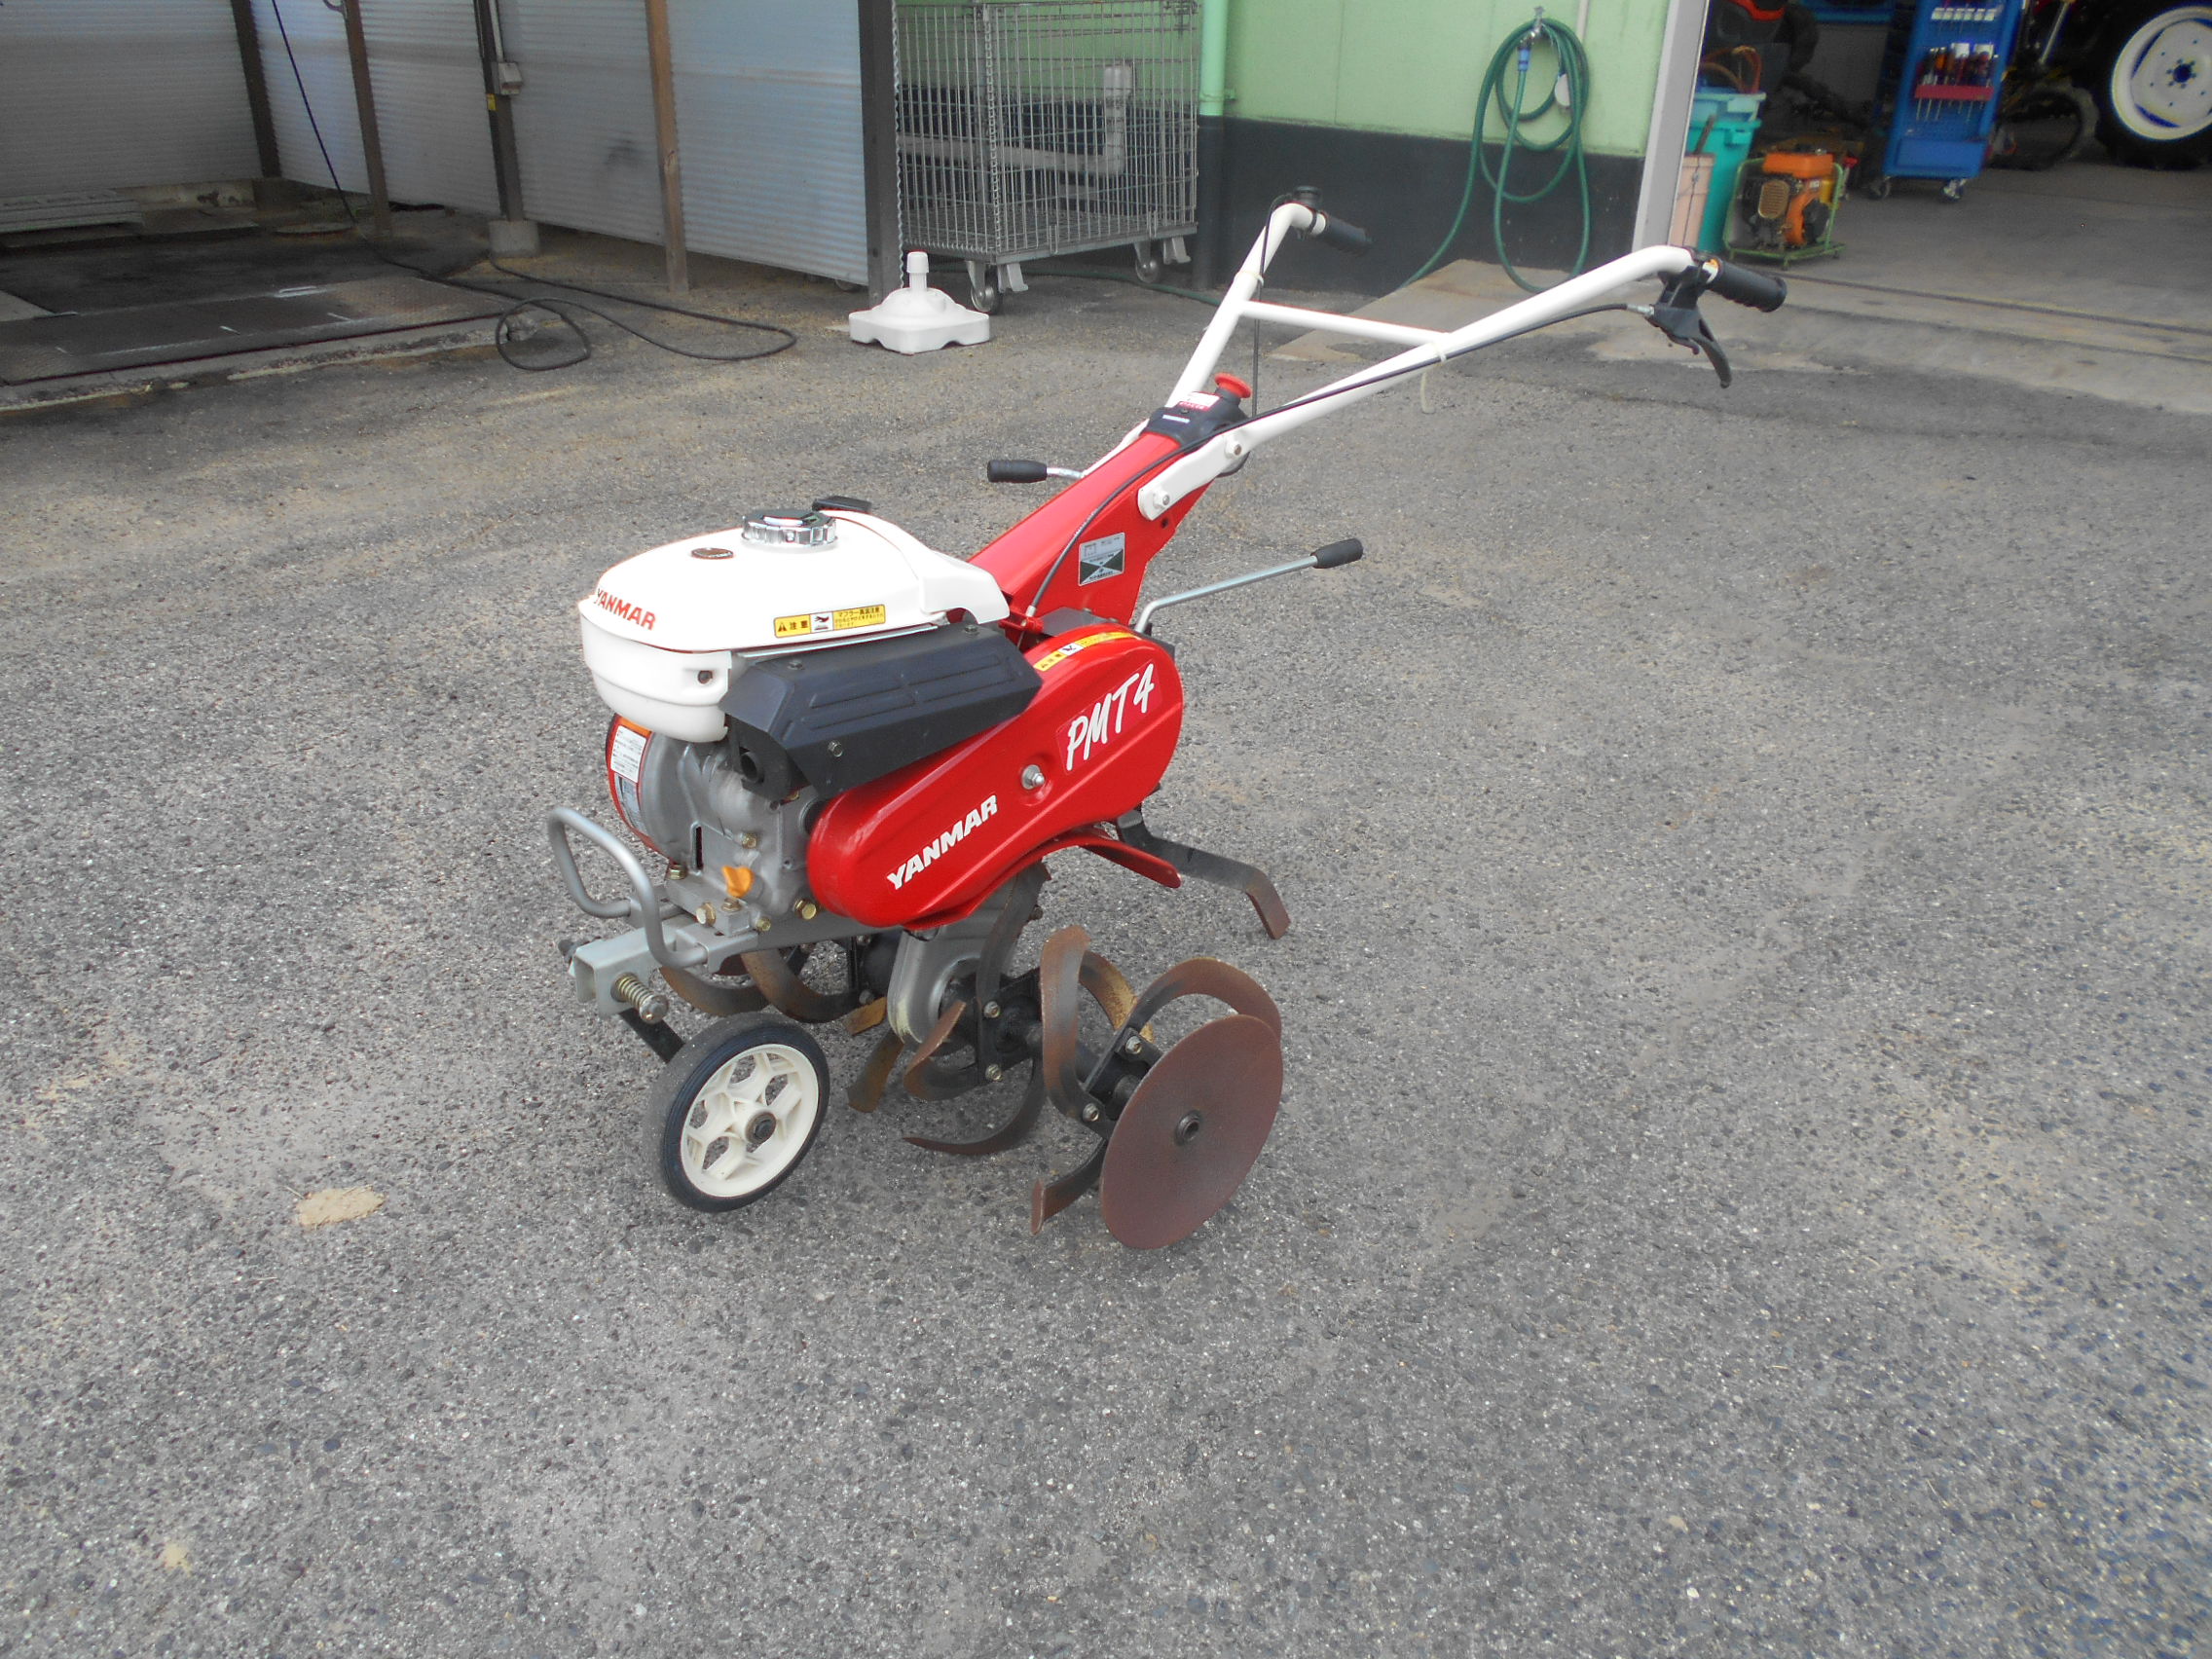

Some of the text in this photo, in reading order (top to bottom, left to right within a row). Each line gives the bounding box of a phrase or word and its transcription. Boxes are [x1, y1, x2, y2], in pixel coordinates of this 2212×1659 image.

[593, 588, 656, 631] YANMAR
[790, 620, 808, 630] 注意
[1066, 663, 1155, 771] PMT4
[886, 794, 999, 891] YANMAR
